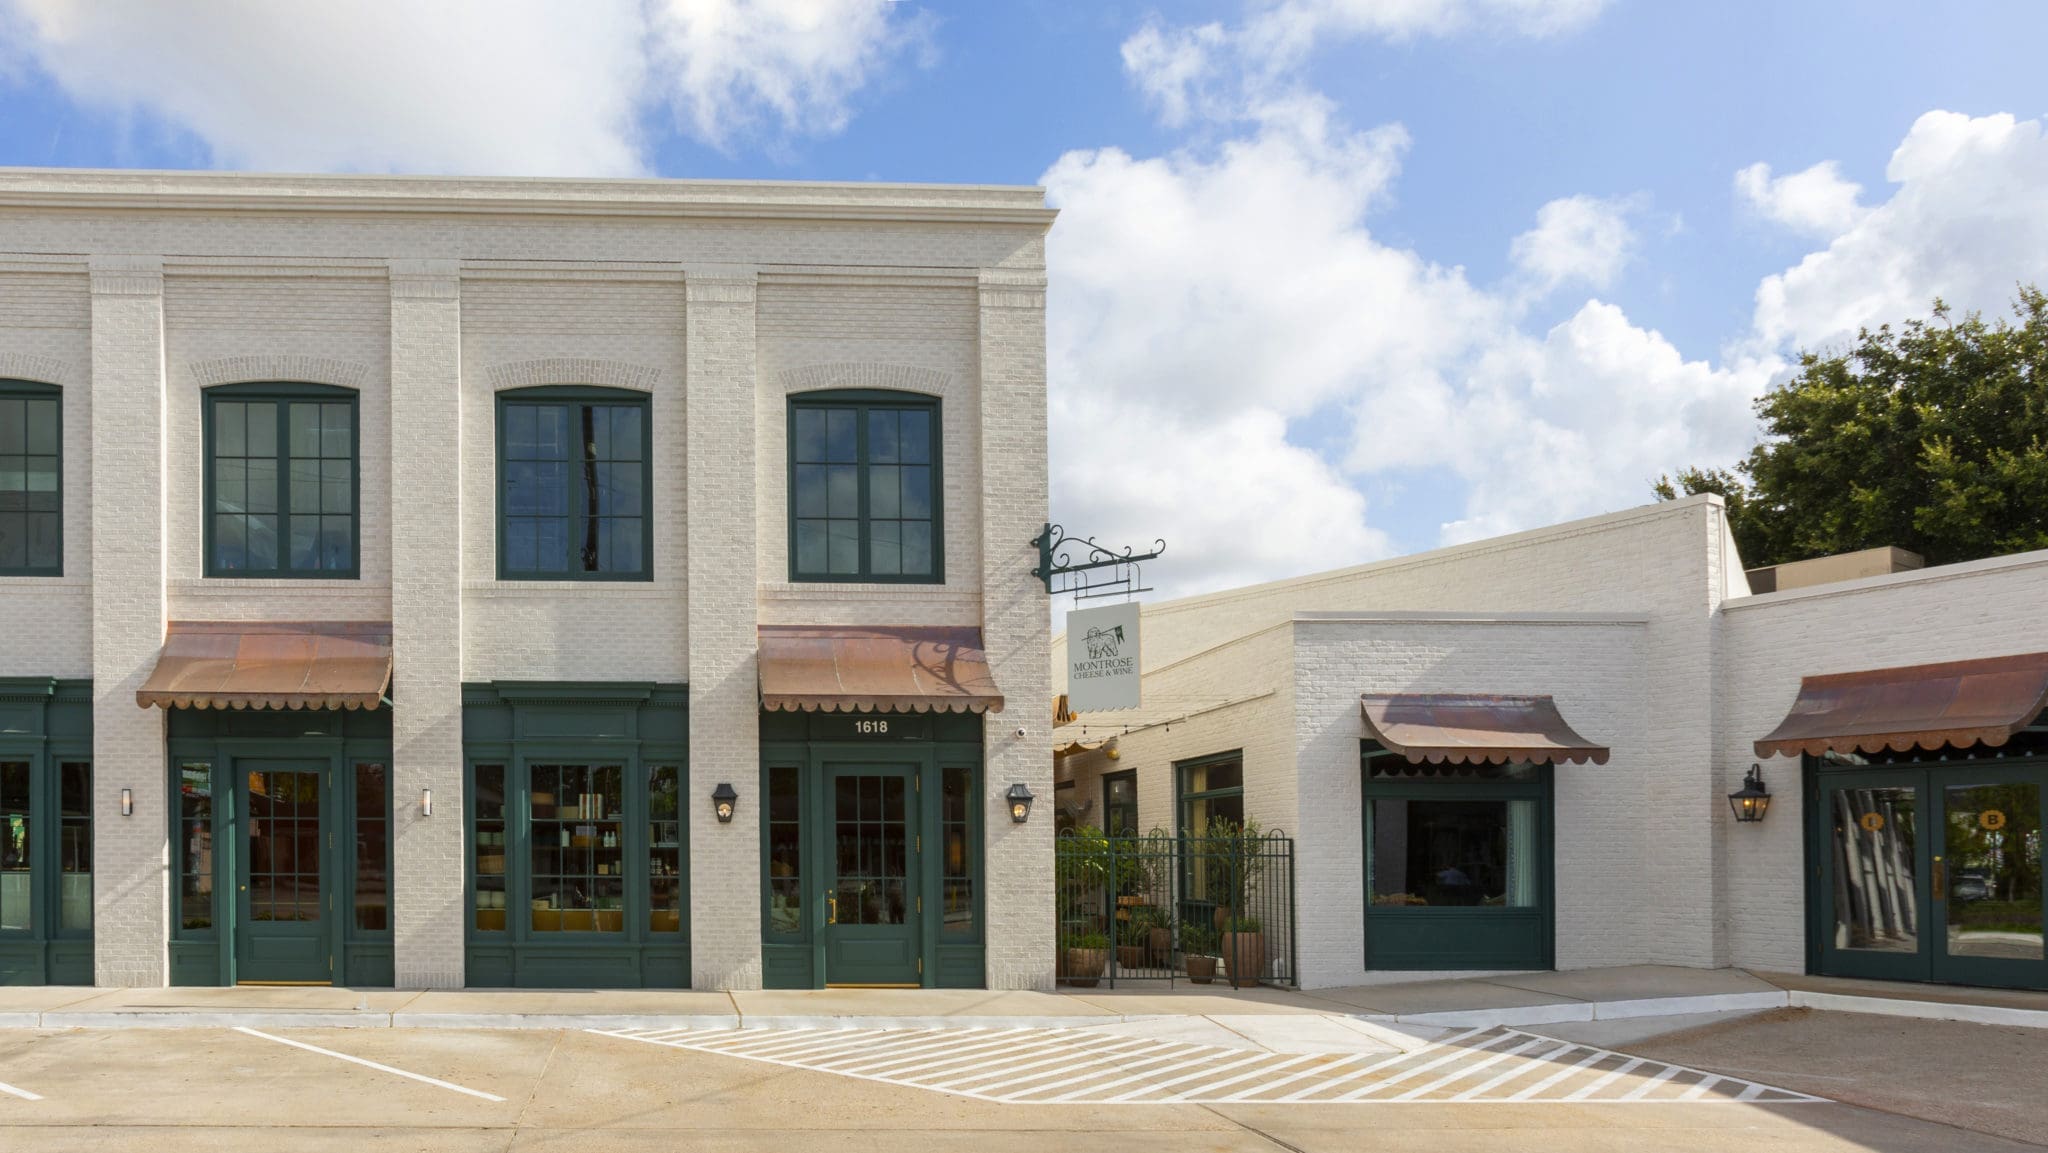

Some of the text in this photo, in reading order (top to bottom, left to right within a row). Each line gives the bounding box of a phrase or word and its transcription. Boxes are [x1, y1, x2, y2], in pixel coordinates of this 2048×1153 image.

[1074, 657, 1133, 672] MONTROSE
[1073, 669, 1104, 680] CHEESE
[1112, 666, 1134, 676] WINE
[855, 720, 888, 733] 1618
[1988, 814, 1999, 825] B
